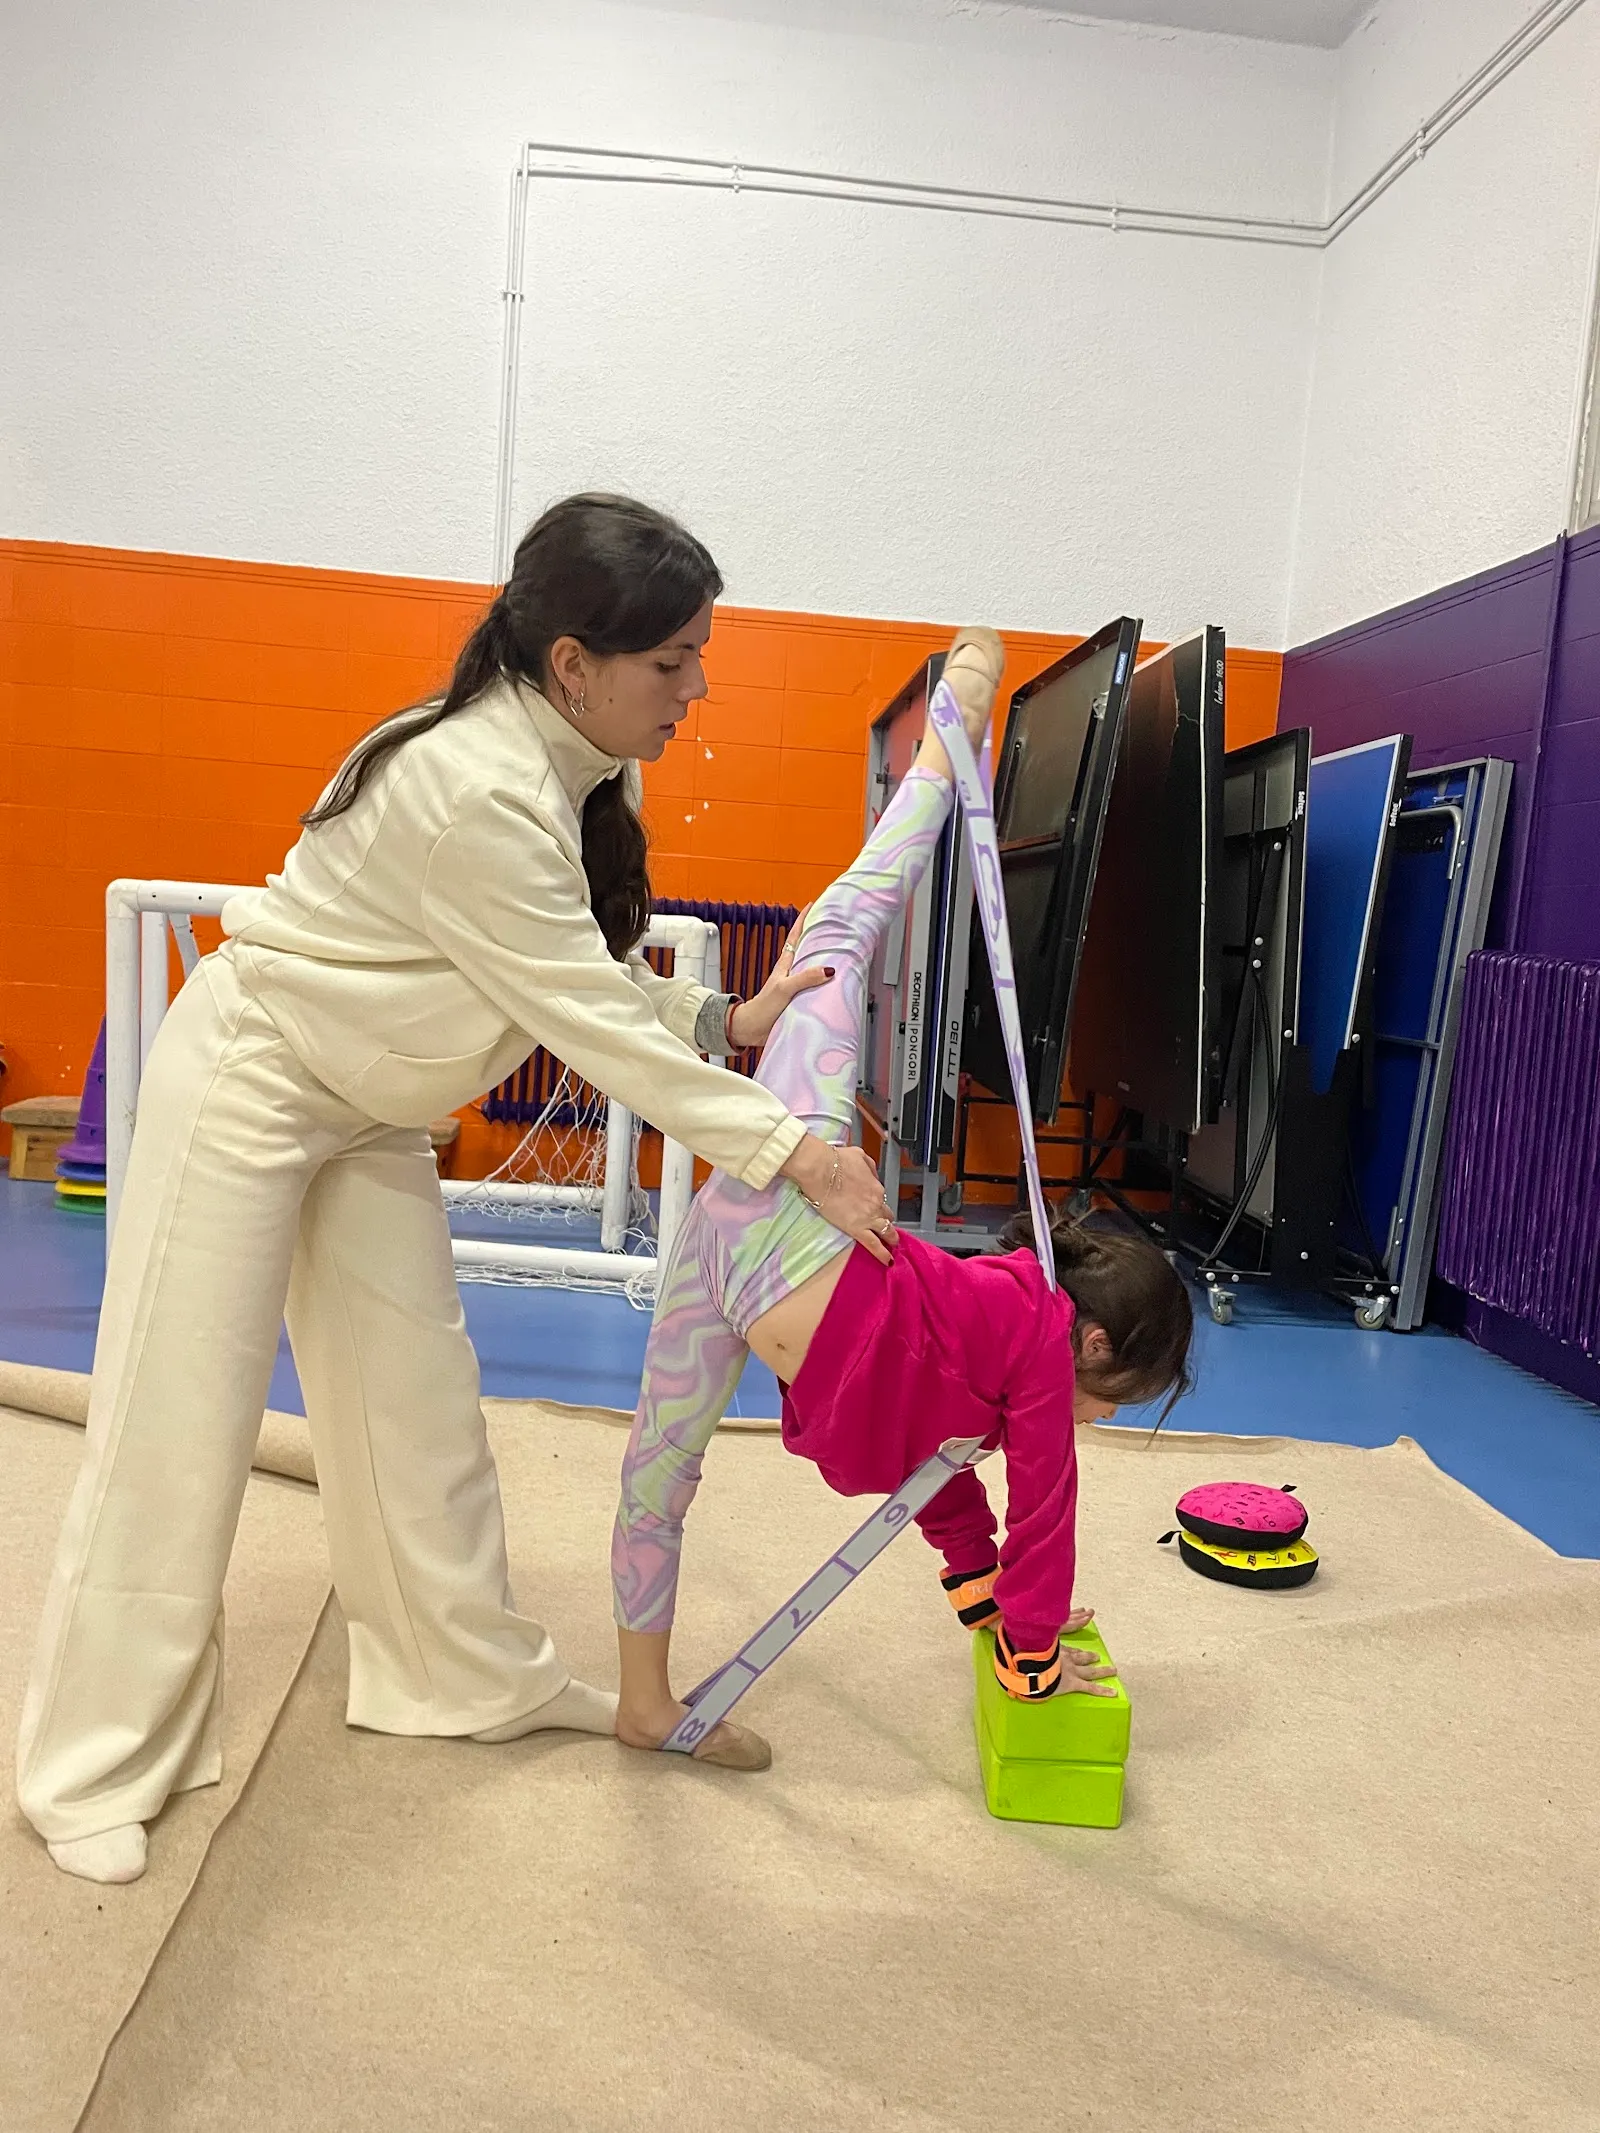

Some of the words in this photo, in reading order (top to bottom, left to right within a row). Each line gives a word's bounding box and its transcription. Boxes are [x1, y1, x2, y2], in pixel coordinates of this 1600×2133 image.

[1215, 659, 1224, 678] 1600
[911, 972, 922, 1022] DECATHLON
[950, 1020, 959, 1045] 130
[908, 1028, 918, 1081] PONGORI
[883, 1503, 909, 1527] 6
[790, 1607, 813, 1630] 7
[677, 1718, 706, 1744] 8
